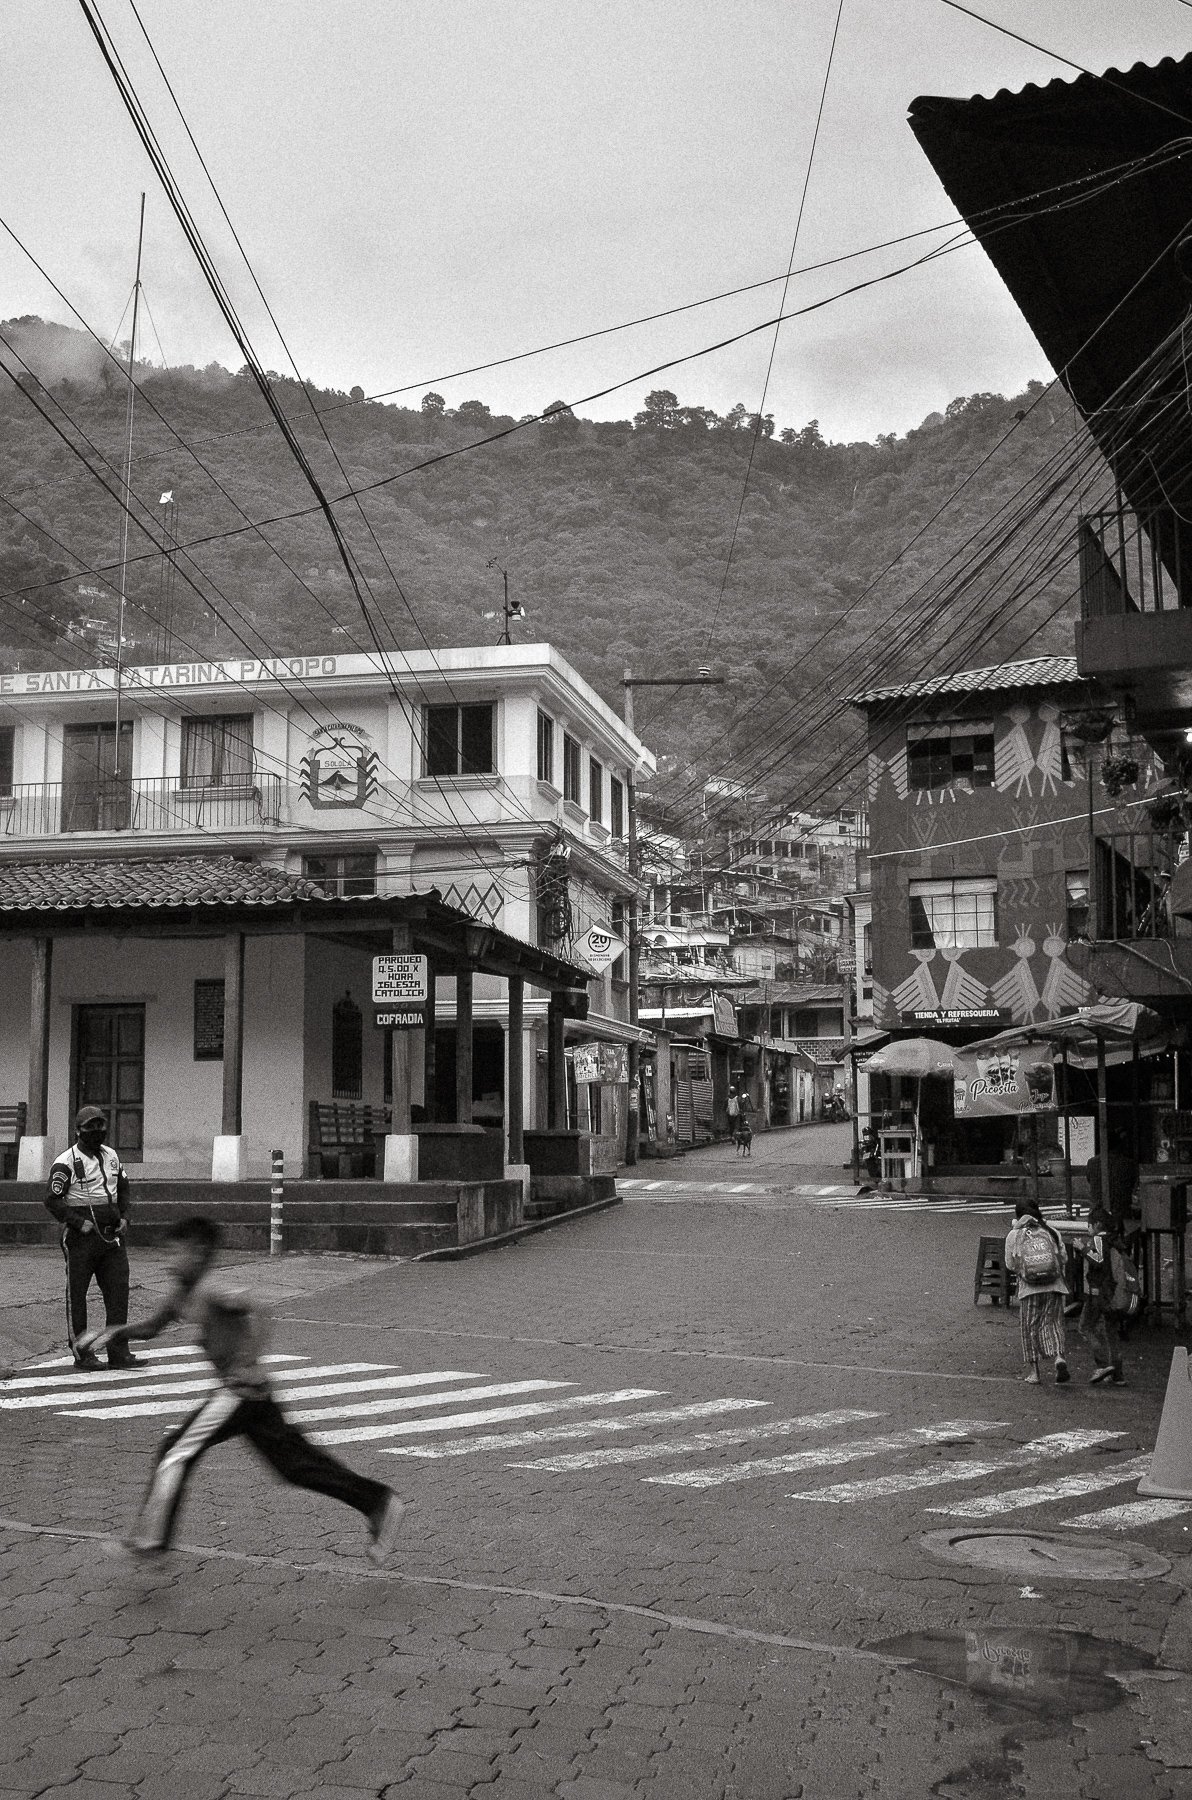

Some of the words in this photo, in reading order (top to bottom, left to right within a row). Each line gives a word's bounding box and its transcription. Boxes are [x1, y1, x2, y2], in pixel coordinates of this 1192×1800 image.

[26, 671, 101, 692] SANTA
[114, 663, 228, 688] CATARINA
[240, 656, 338, 680] PALOPO
[592, 935, 607, 944] 20
[378, 956, 422, 965] PARQUEO
[413, 965, 419, 973] X
[388, 973, 414, 981] HORA
[377, 981, 421, 989] IGLESIA
[375, 989, 424, 997] CATOLICA
[914, 1011, 939, 1019] TIENDA
[940, 1010, 947, 1018] Y
[947, 1009, 1000, 1018] REFRESQUERIA
[376, 1013, 424, 1025] COFRADIA
[970, 1077, 1019, 1101] Picosita
